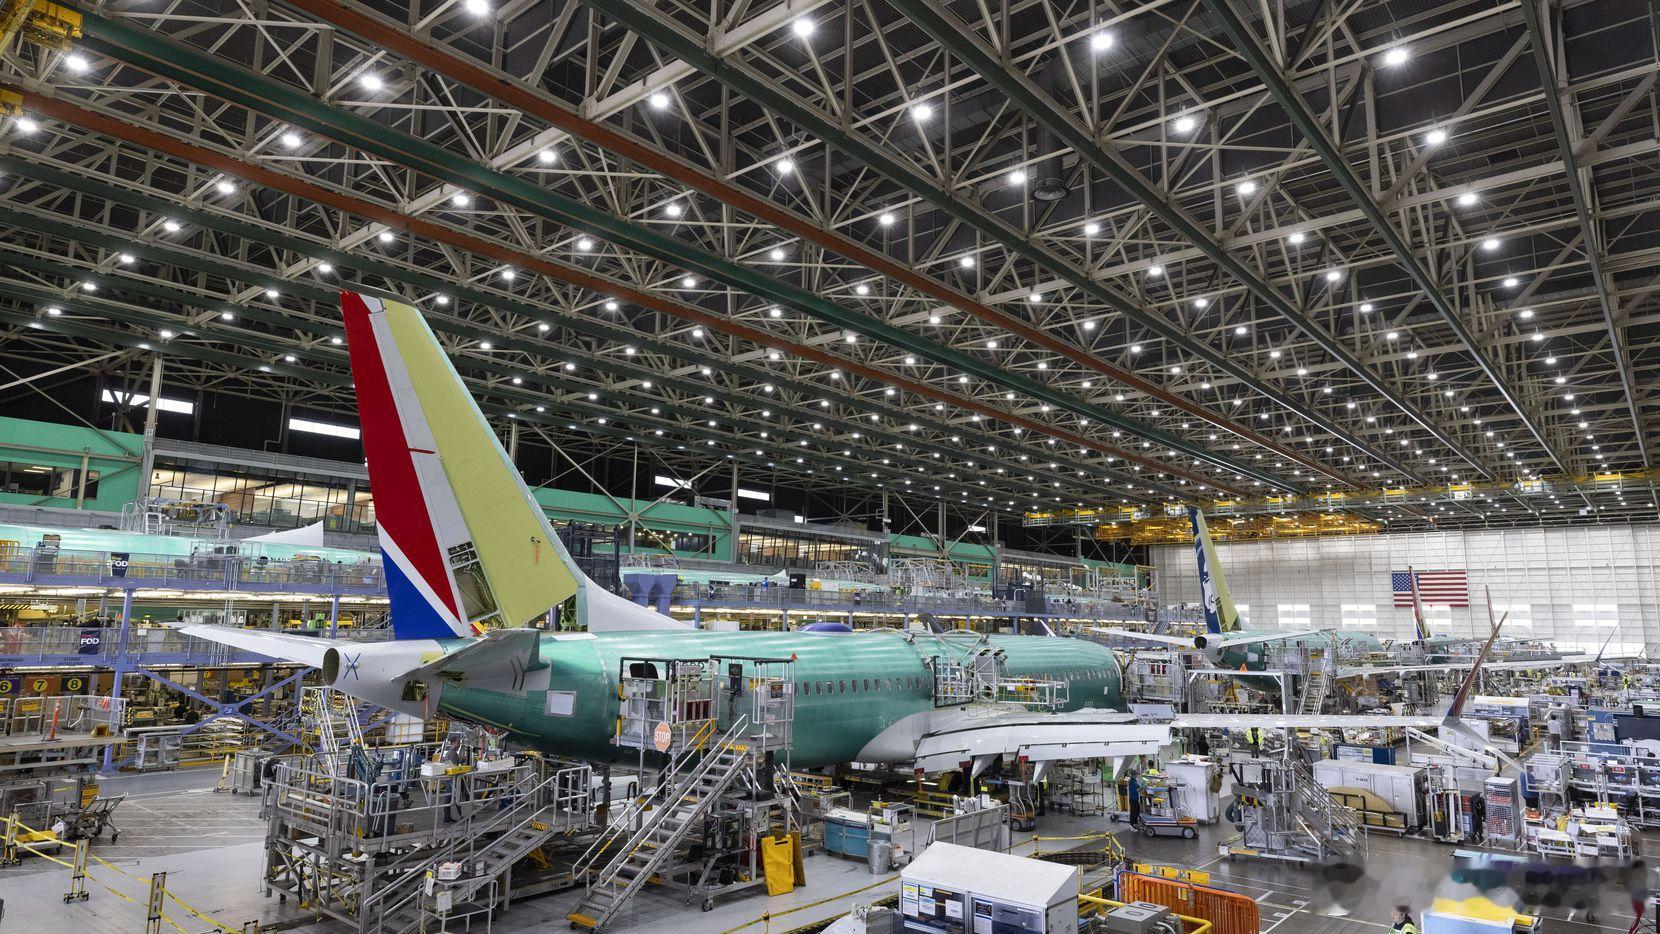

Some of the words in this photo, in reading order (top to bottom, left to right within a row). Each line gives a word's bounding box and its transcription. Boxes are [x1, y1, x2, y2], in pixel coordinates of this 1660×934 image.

[80, 637, 100, 645] FOD
[0, 681, 9, 692] 6
[36, 680, 45, 690] 7
[70, 679, 79, 689] 8
[655, 730, 670, 743] STOP
